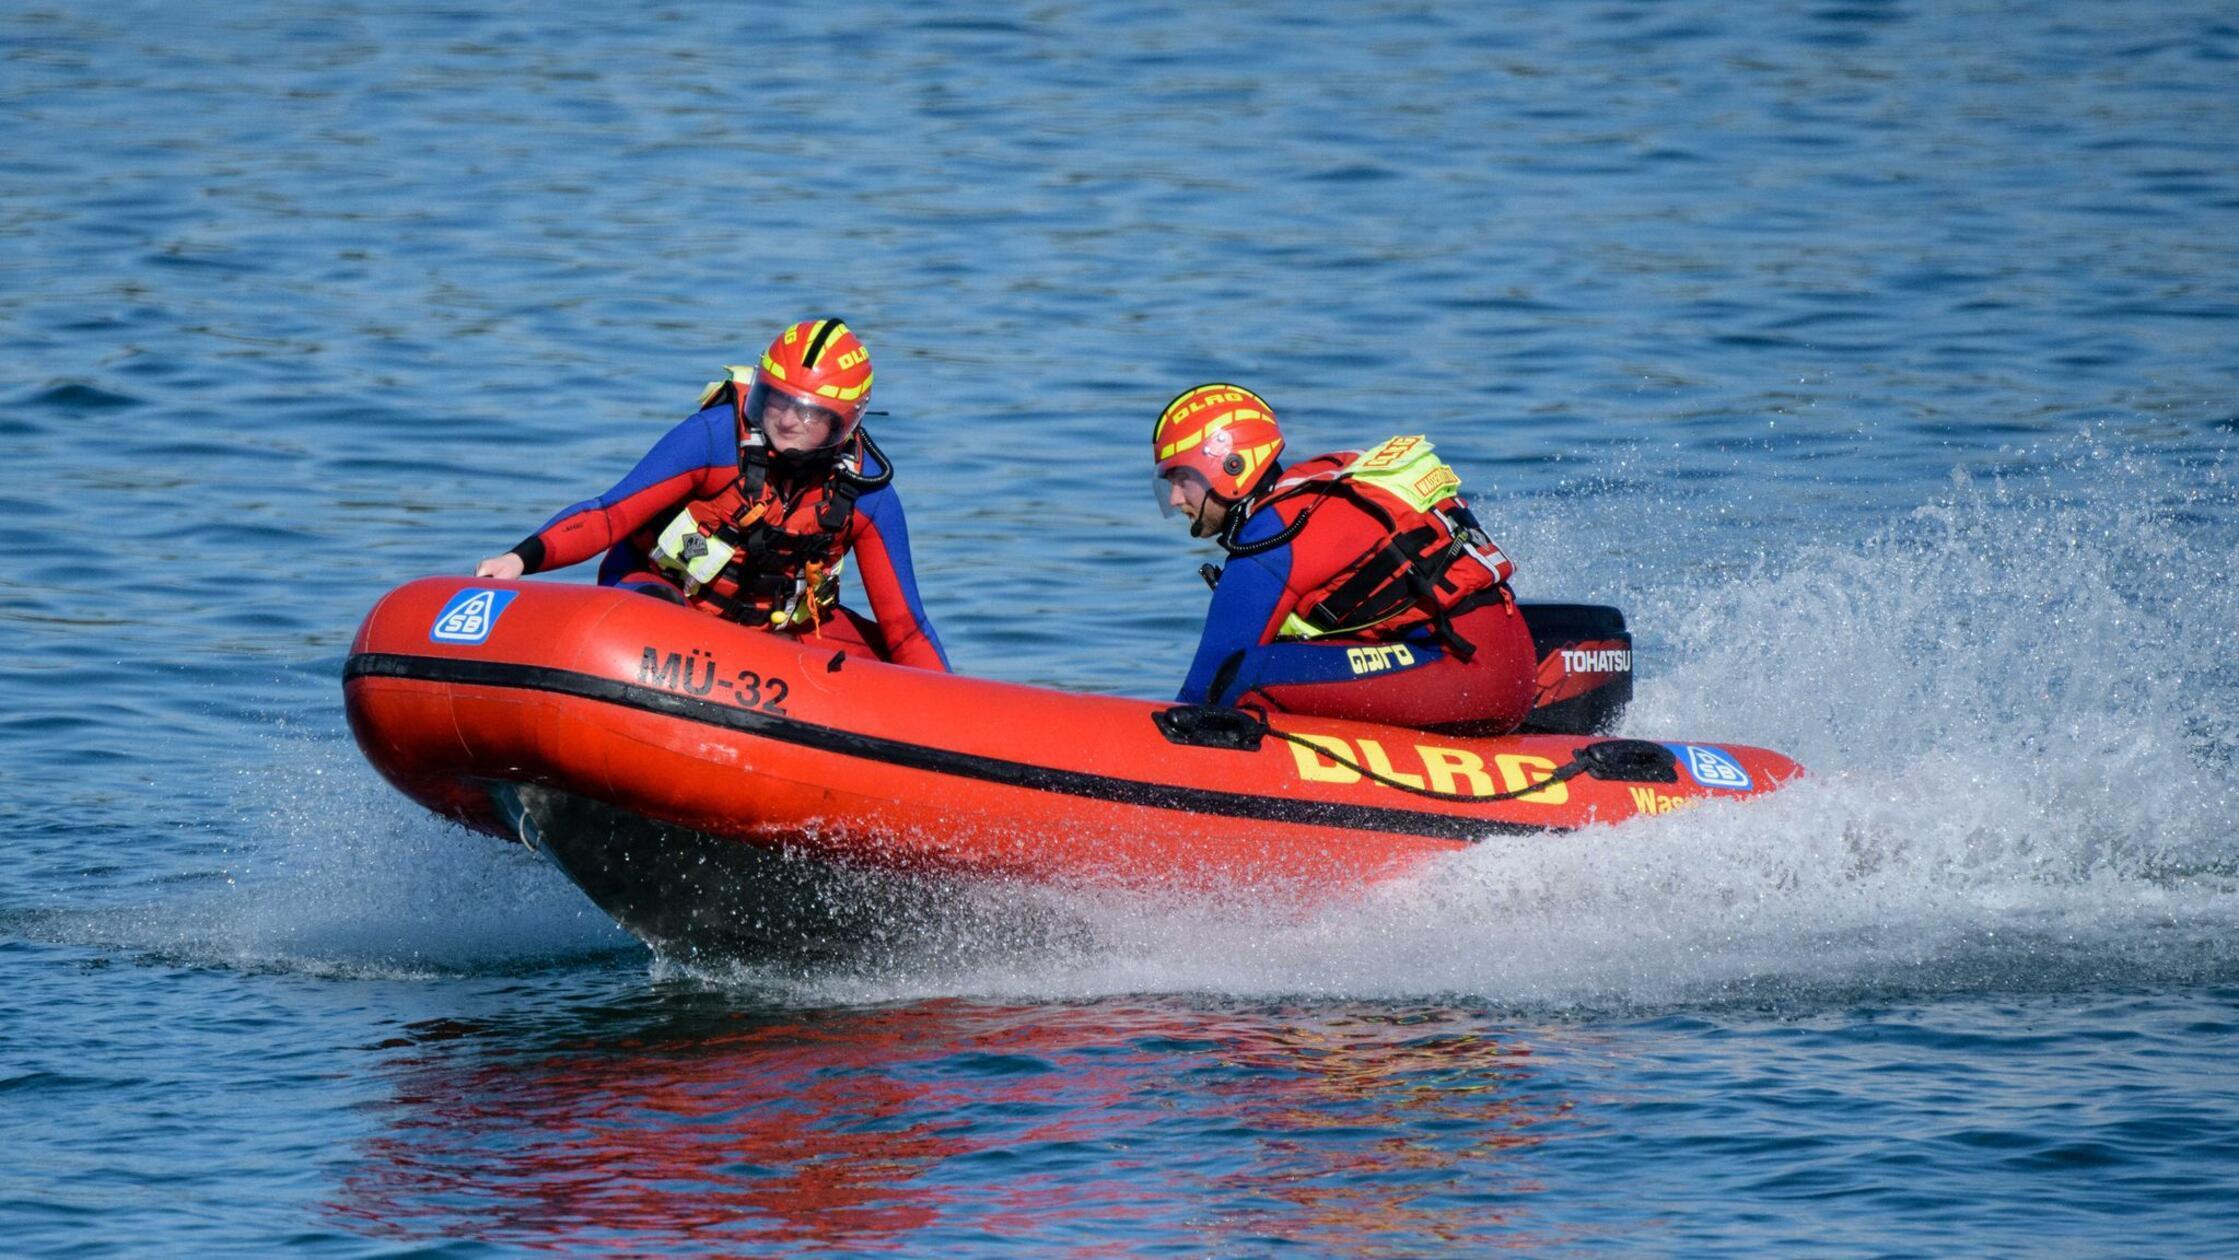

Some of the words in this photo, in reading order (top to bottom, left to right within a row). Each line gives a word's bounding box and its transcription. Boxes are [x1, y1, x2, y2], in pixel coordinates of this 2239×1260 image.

[1172, 392, 1244, 425] DLRG
[639, 646, 789, 716] MÜ-32
[1561, 650, 1631, 672] TOHATSU
[1287, 732, 1568, 805] DLRG
